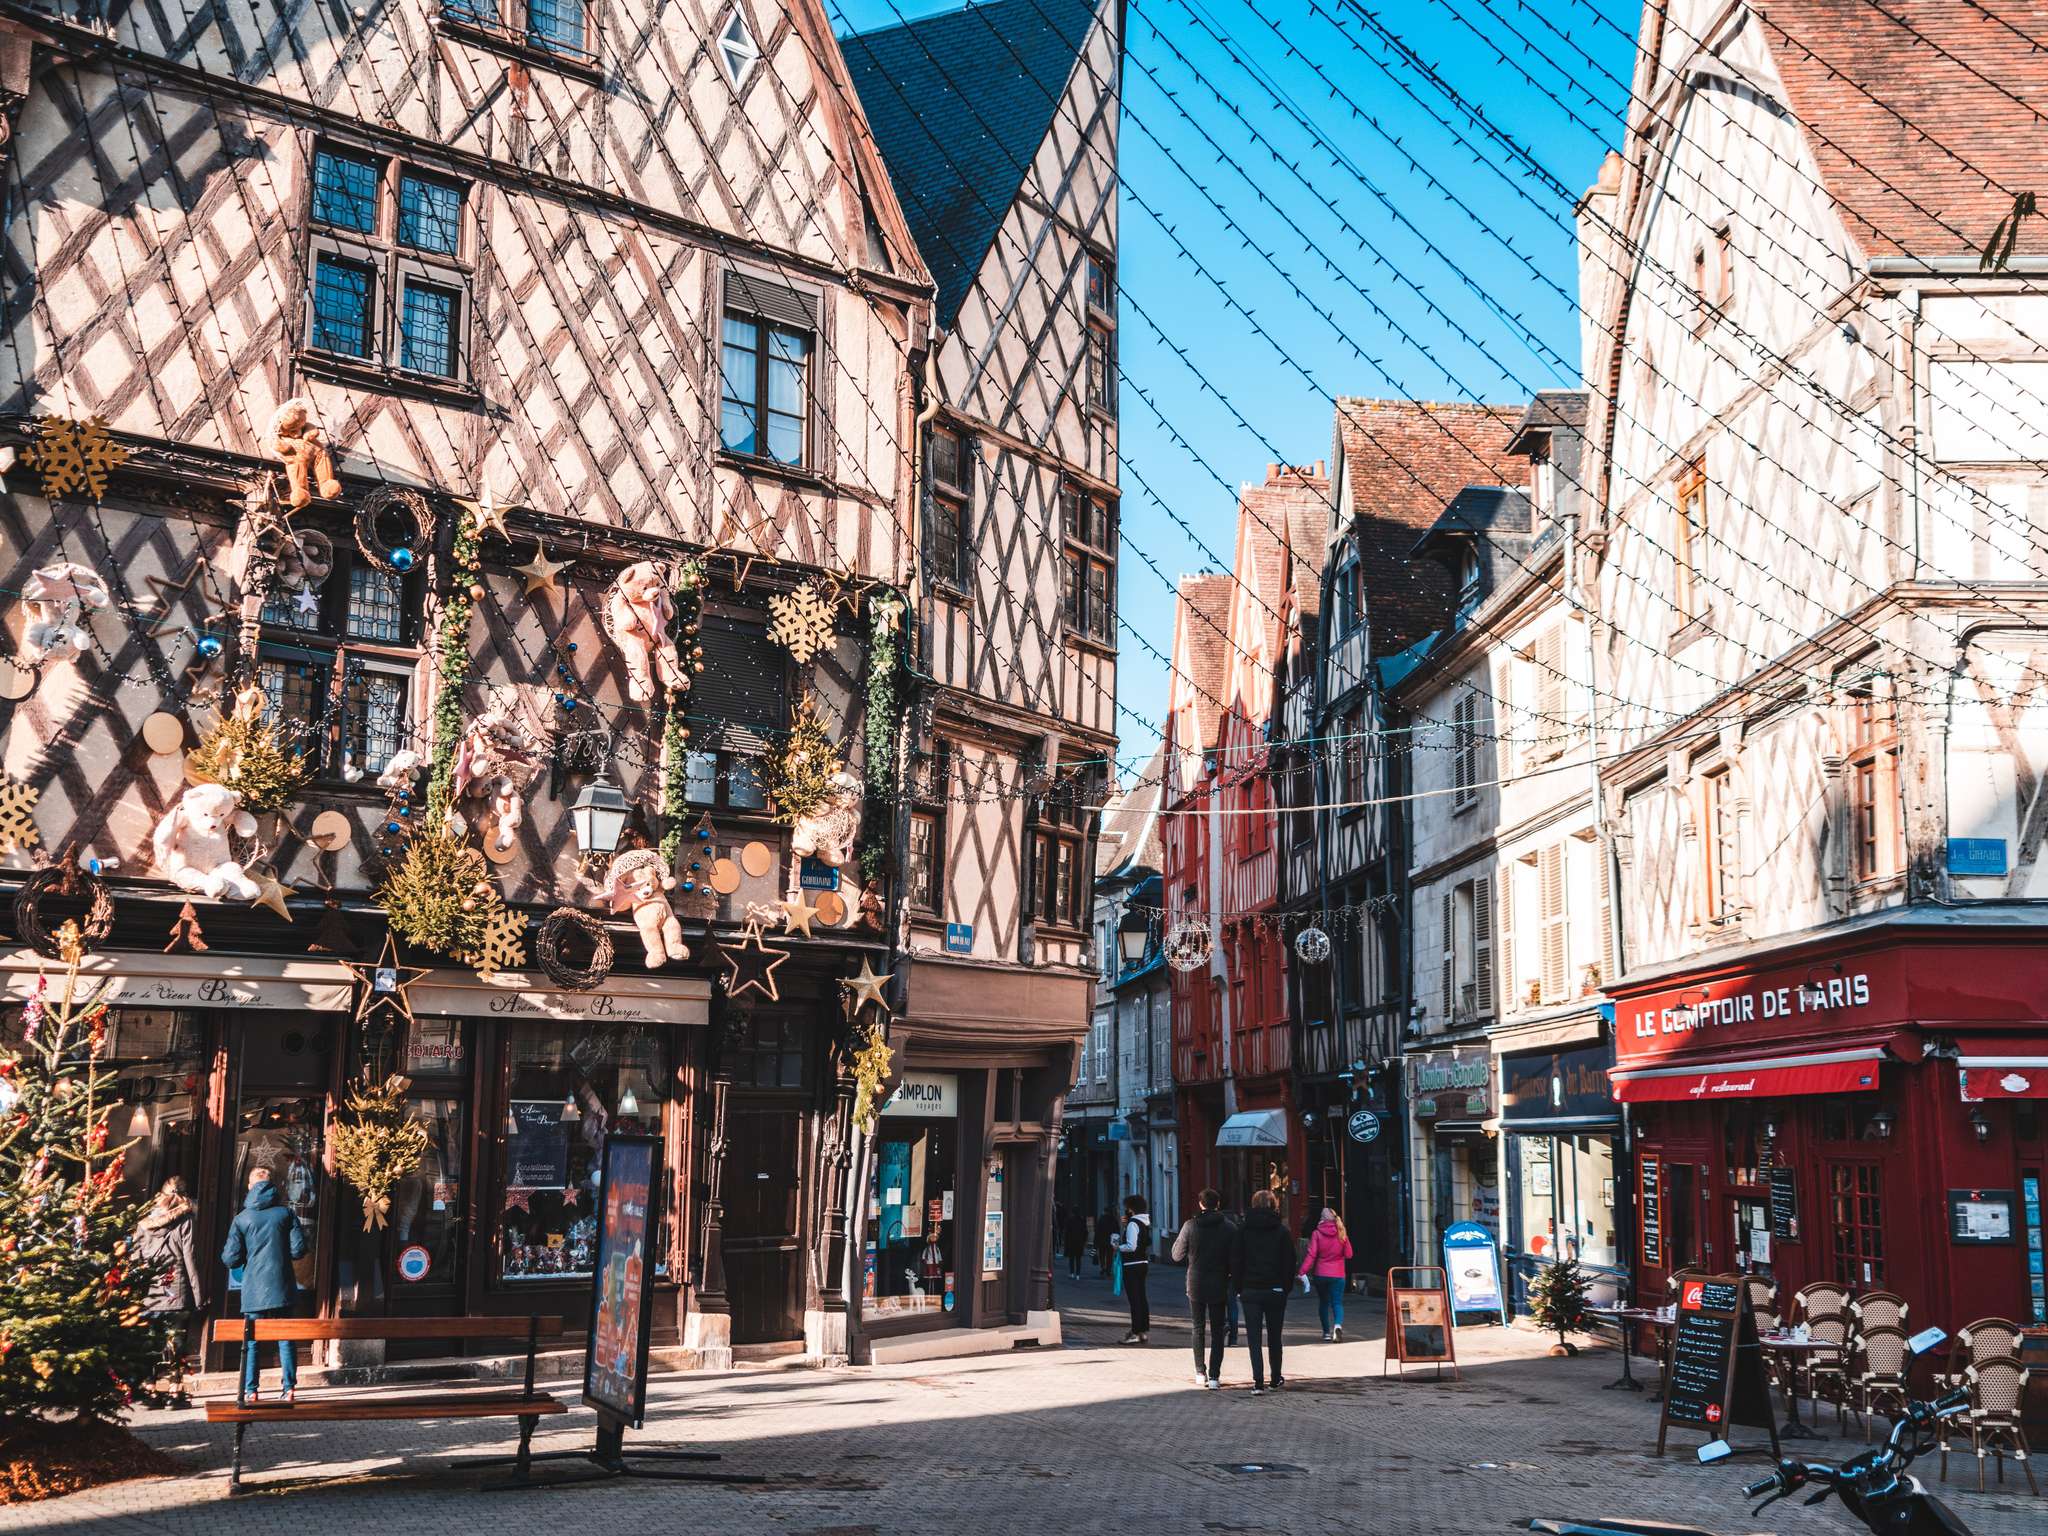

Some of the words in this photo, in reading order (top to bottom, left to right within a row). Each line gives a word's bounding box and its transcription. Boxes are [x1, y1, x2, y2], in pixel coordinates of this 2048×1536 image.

[590, 994, 642, 1019] Bourges
[1635, 1010, 1657, 1038] LE
[1762, 988, 1792, 1018] DE
[899, 1084, 942, 1101] SIMPLON
[916, 1103, 942, 1112] voyages
